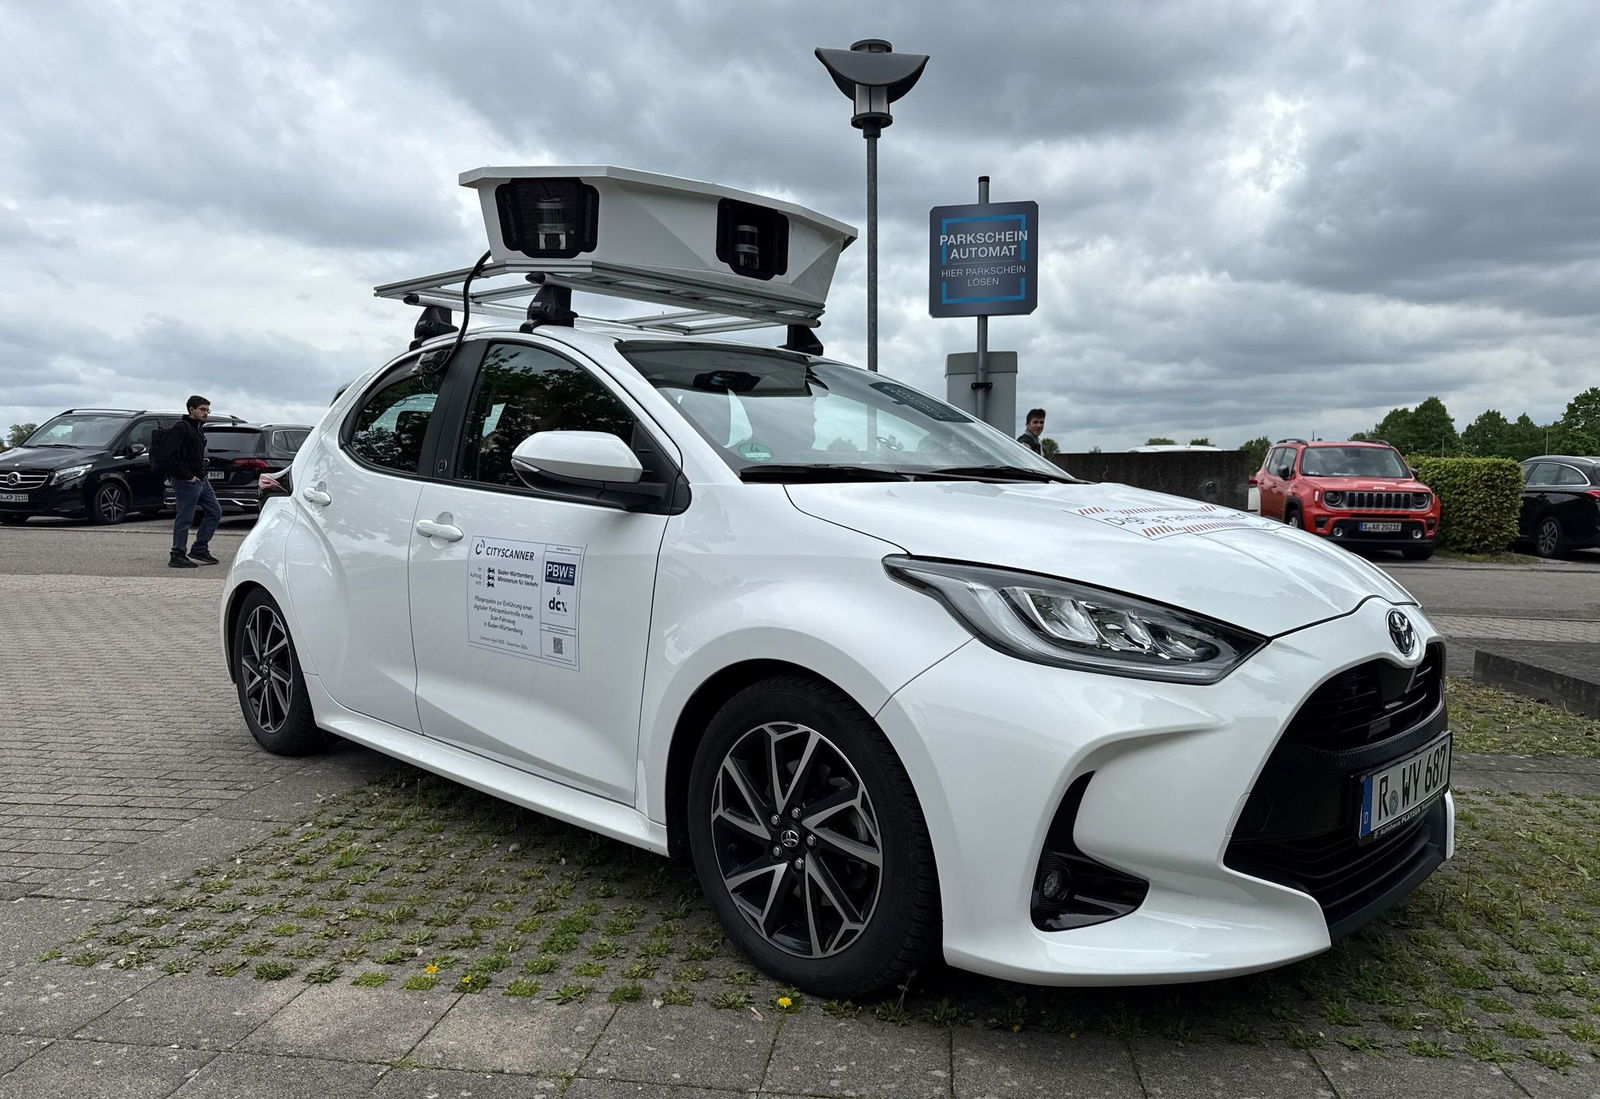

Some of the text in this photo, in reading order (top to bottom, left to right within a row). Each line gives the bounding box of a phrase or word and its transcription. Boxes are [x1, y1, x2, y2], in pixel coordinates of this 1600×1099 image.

[940, 230, 1028, 246] PARKSCHEIN
[950, 245, 1017, 260] AUTOMAT
[941, 265, 1026, 278] HIER PARKSCHEIN
[486, 546, 535, 561] CITYSCANNER
[498, 569, 534, 580] Baden-Württemberg
[547, 564, 568, 578] PBW
[497, 576, 518, 584] Ministerium
[556, 586, 561, 595] &
[1379, 744, 1447, 821] R WY 687
